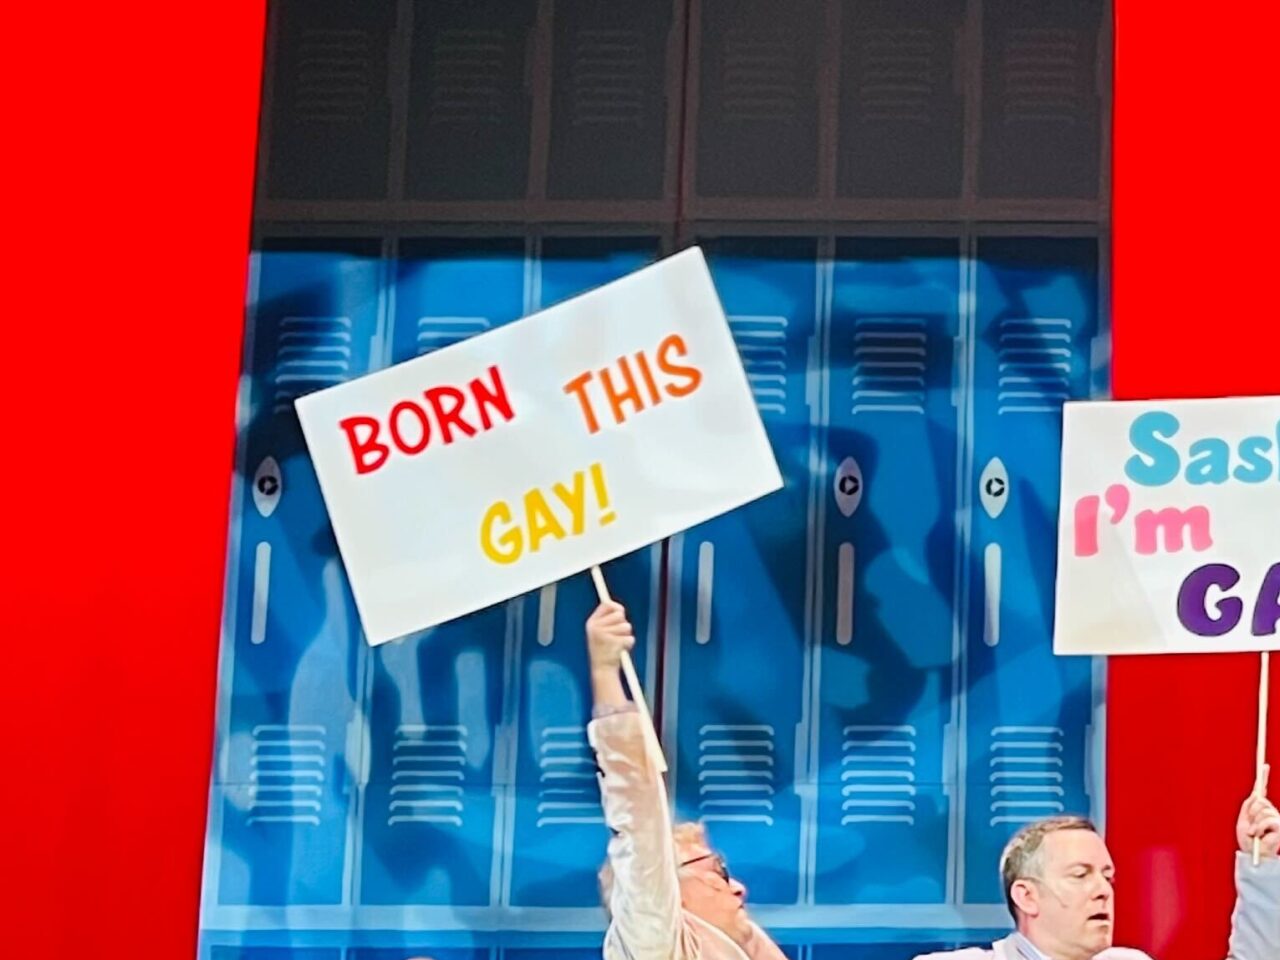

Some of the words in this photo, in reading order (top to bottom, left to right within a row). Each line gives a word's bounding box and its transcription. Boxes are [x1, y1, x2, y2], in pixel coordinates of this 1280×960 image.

[339, 365, 515, 475] BORN
[563, 334, 703, 434] THIS
[480, 463, 617, 565] GAY!
[1074, 484, 1213, 557] I'm
